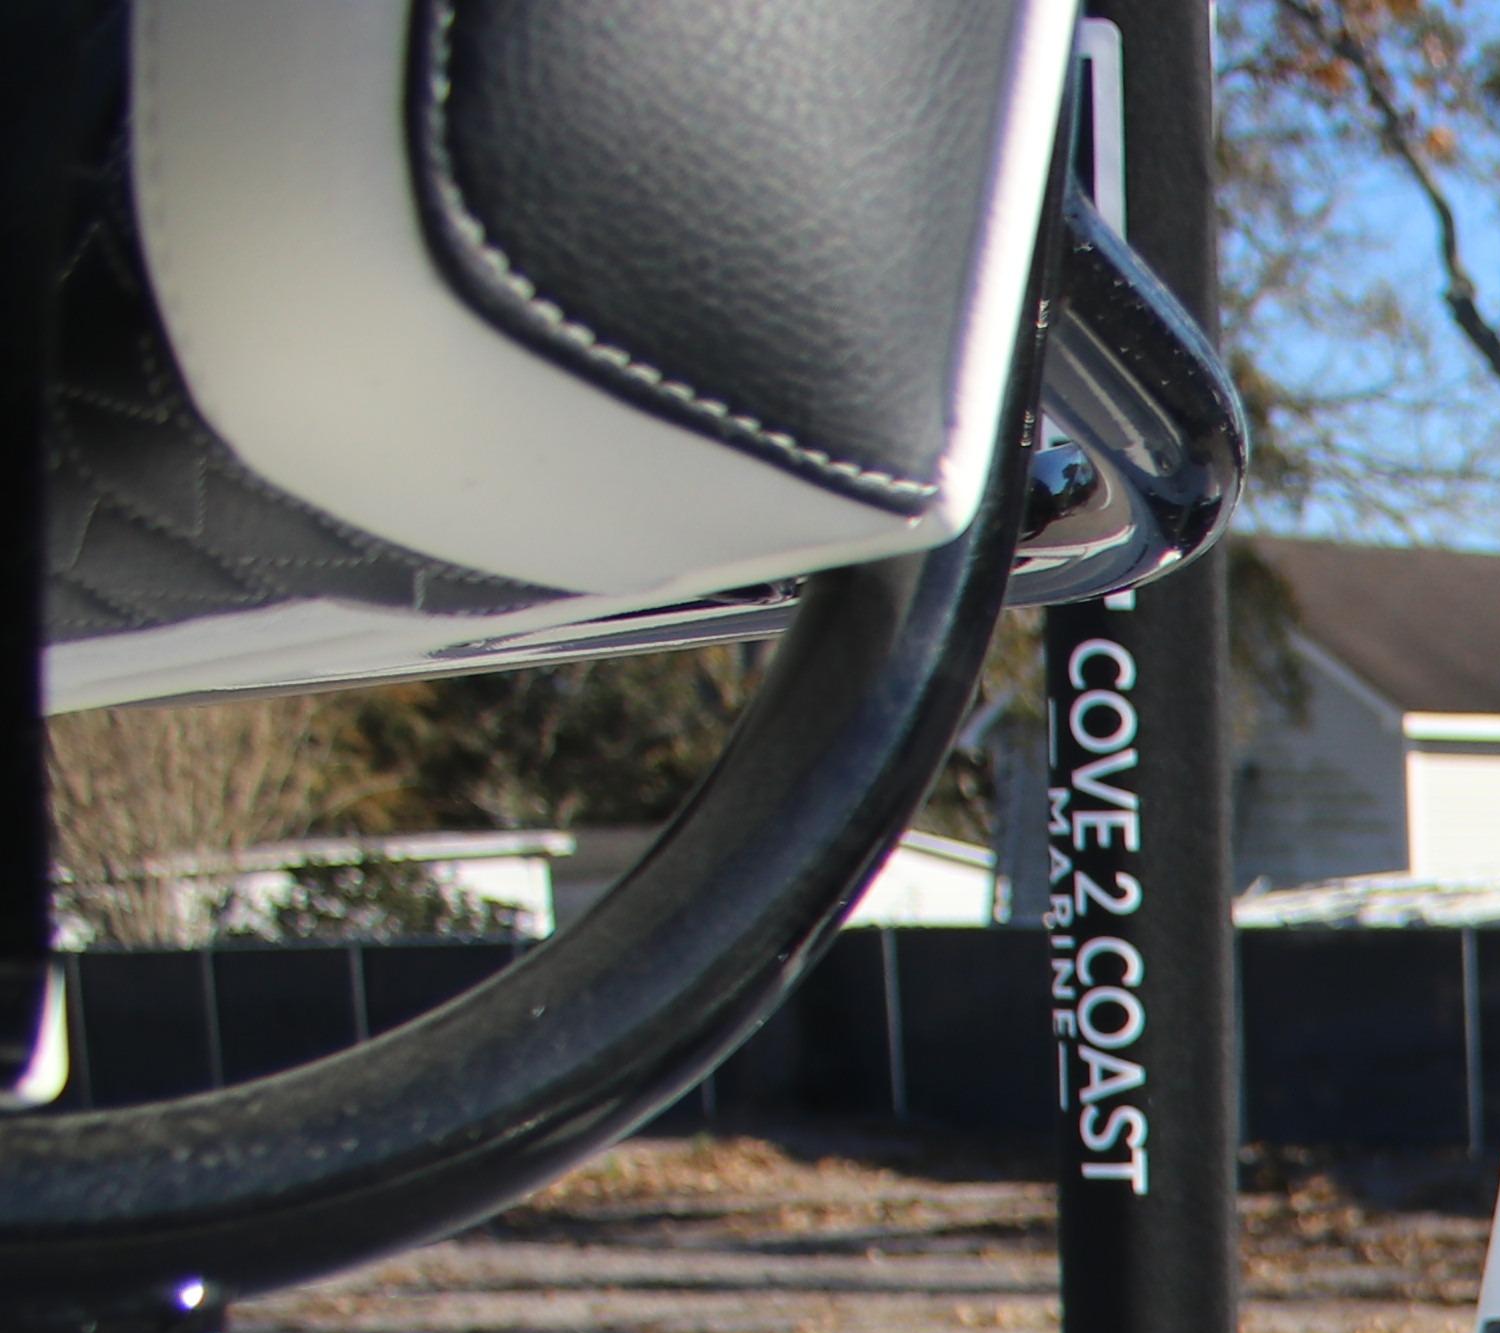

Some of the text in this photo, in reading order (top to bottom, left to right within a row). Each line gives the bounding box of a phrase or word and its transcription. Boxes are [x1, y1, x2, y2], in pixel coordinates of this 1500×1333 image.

[1047, 786, 1077, 1041] MARINE
[1068, 638, 1148, 1195] COVE 2 COAST
